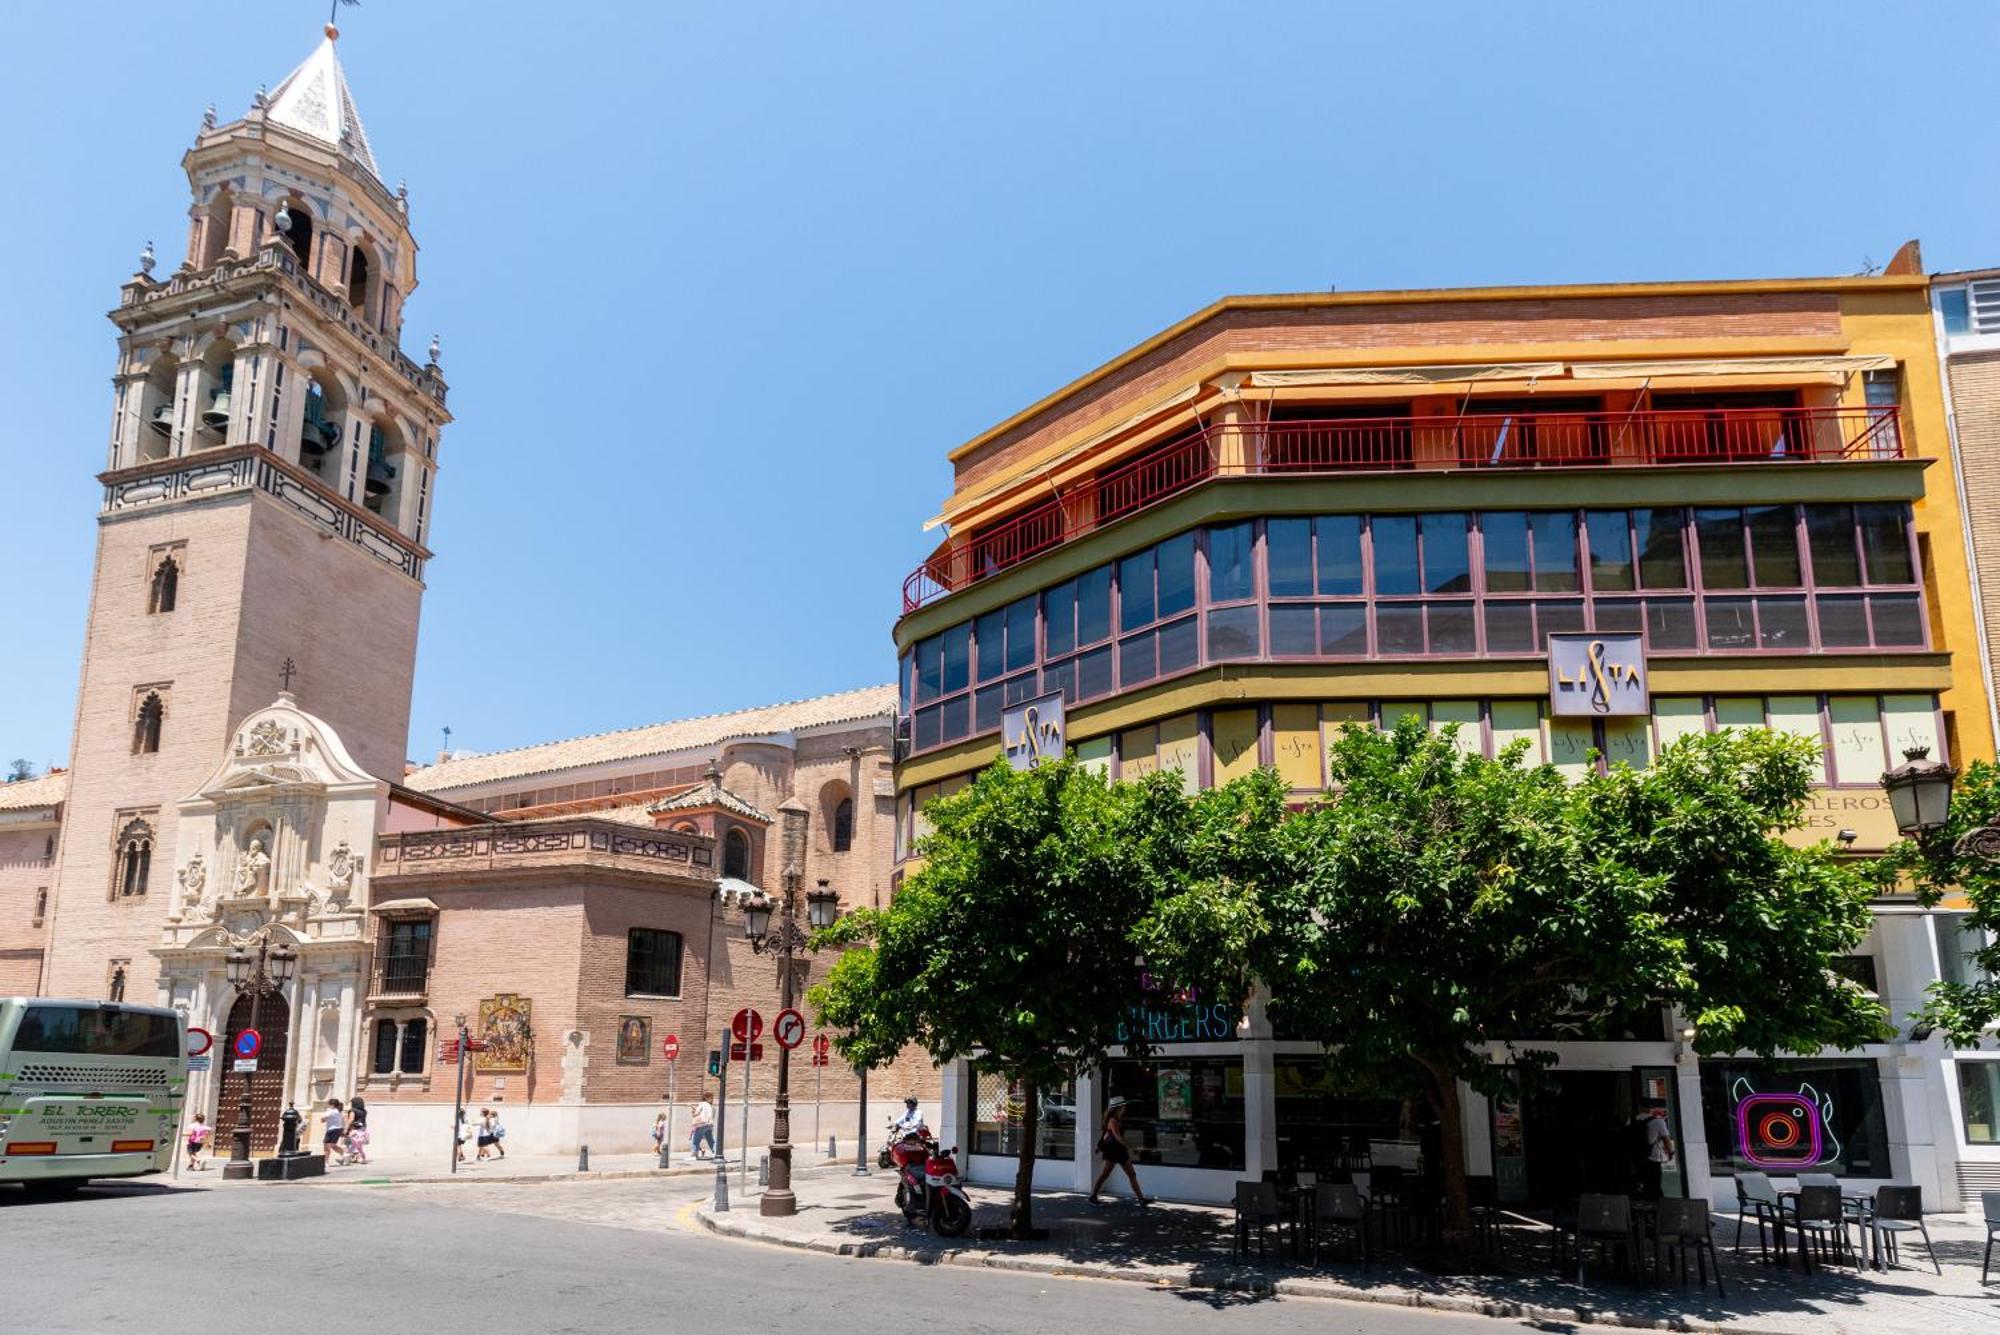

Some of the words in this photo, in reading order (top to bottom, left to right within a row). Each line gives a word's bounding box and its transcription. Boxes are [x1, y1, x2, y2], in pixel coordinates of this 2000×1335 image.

[1557, 640, 1640, 711] LISTA
[1006, 706, 1060, 766] LISTA
[1281, 736, 1313, 758] LISTA
[42, 1105, 65, 1116] EL
[76, 1105, 139, 1117] TORERO
